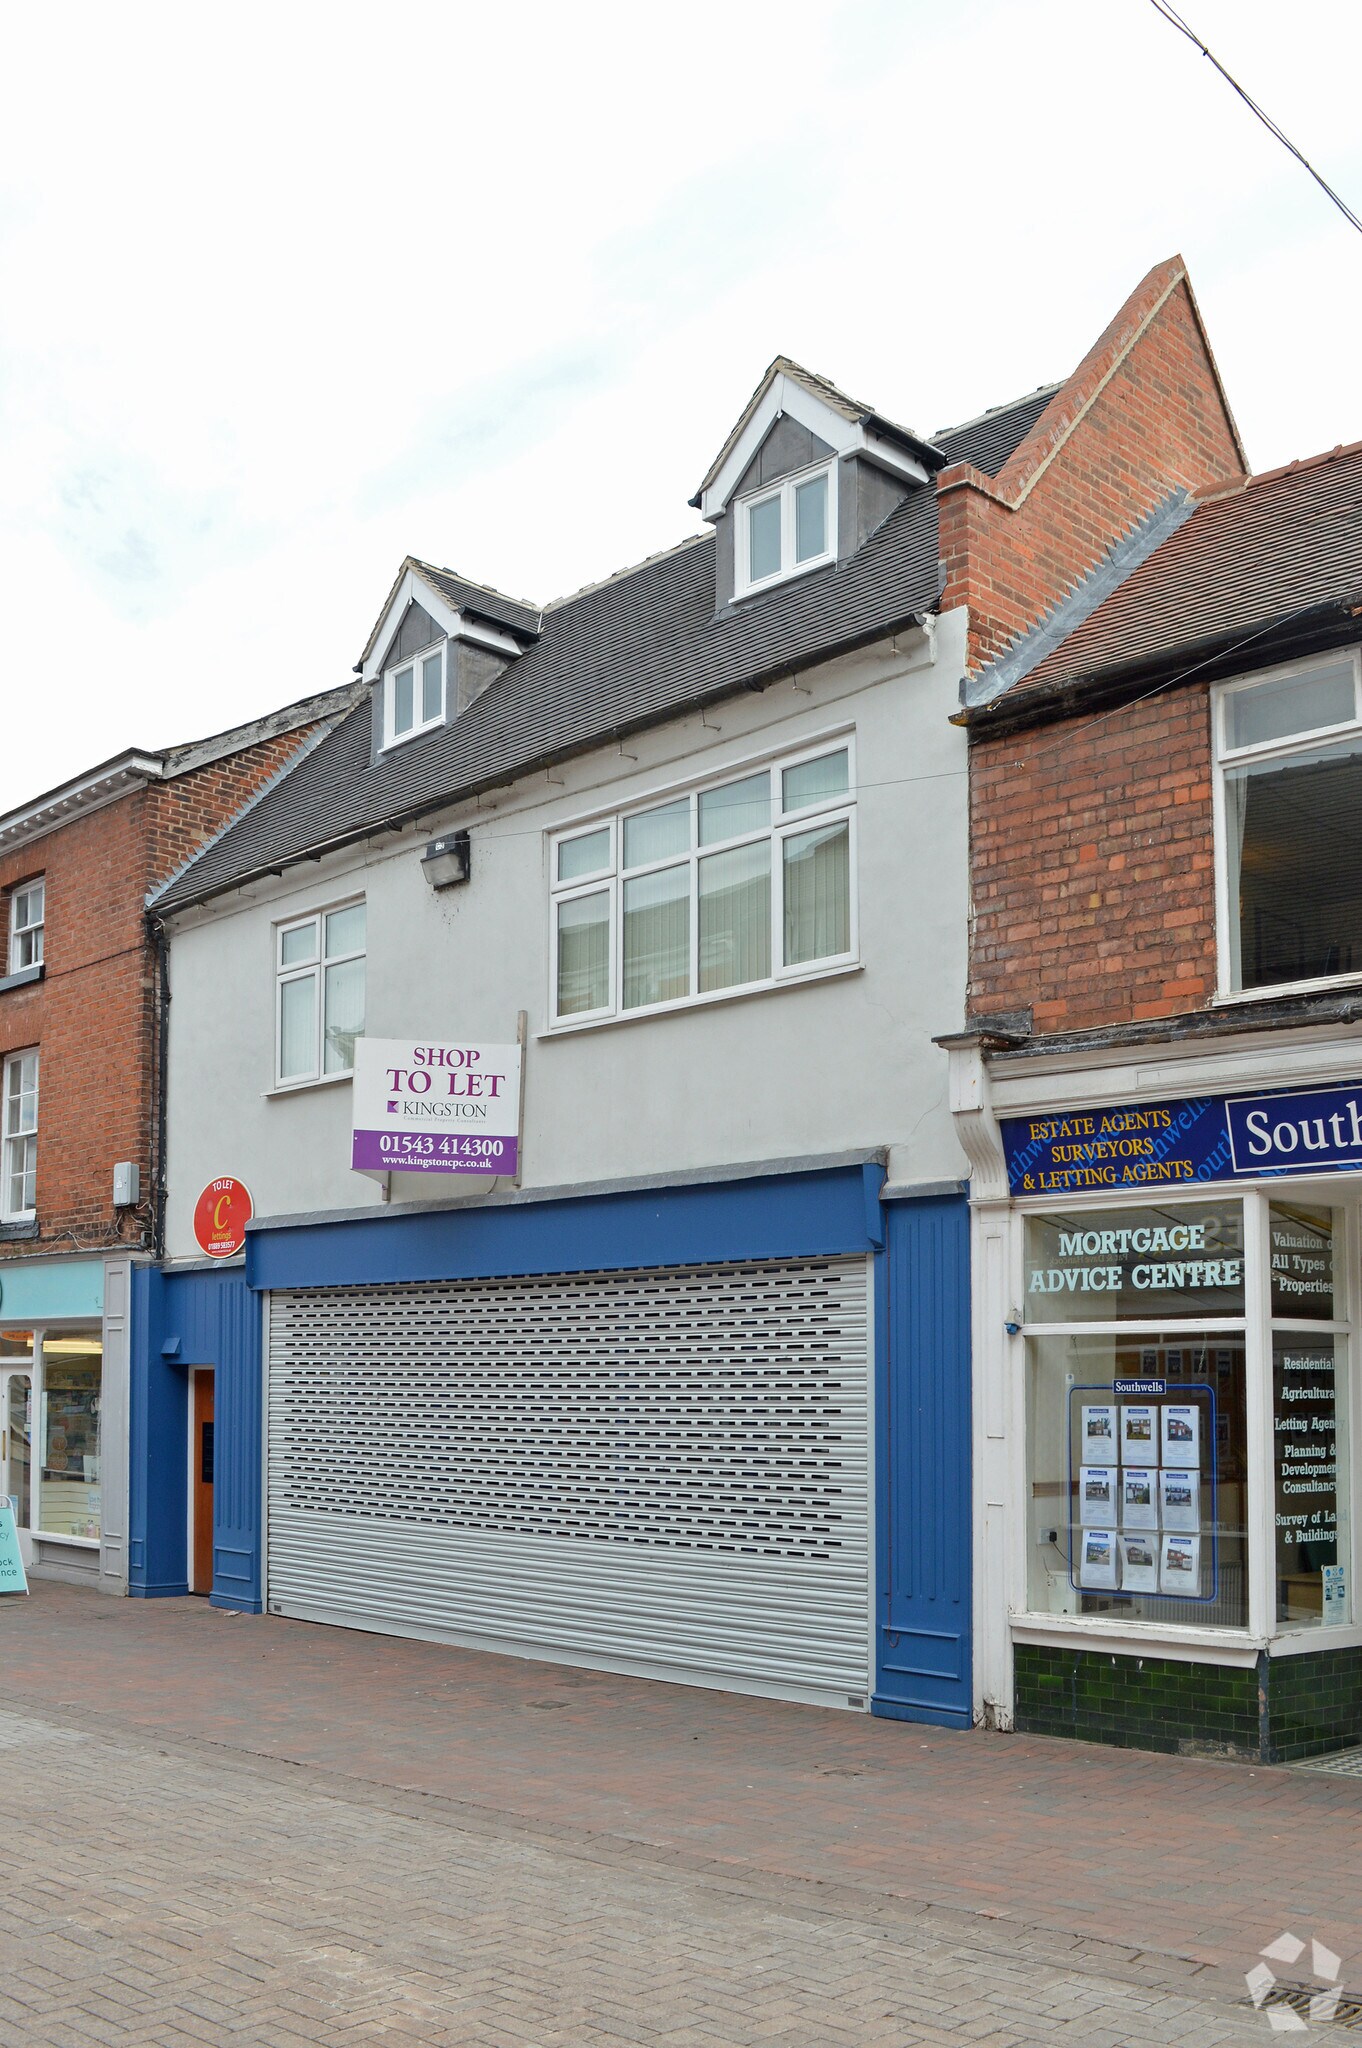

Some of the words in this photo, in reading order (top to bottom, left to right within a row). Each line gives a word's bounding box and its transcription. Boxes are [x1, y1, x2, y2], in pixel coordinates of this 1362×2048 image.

[413, 1047, 480, 1068] SHOP
[387, 1069, 432, 1094] TO
[447, 1072, 506, 1098] LET
[403, 1101, 487, 1118] KINGSTON
[1029, 1117, 1095, 1140] ESTATE
[1100, 1109, 1172, 1133] AGENTS
[379, 1135, 434, 1155] 01543
[438, 1136, 504, 1157] 414300
[1051, 1137, 1154, 1163] SURVEYORS
[382, 1155, 493, 1169] www.kingstoncpc.co.uk
[1023, 1173, 1036, 1190] &
[1038, 1166, 1116, 1189] LETTING
[1121, 1159, 1194, 1182] AGENTS
[212, 1180, 222, 1192] TO
[222, 1179, 234, 1190] LET
[213, 1195, 231, 1230] C
[211, 1232, 232, 1241] lettings
[1058, 1224, 1205, 1257] MORTGAGE
[1272, 1231, 1323, 1249] Valuation
[1272, 1254, 1289, 1269] All
[1292, 1254, 1326, 1274] Types
[1029, 1266, 1123, 1293] ADVICE
[1131, 1260, 1241, 1290] CENTRE
[1279, 1276, 1334, 1296] Properties
[1283, 1357, 1335, 1370] Residential
[1115, 1381, 1163, 1392] Southwells
[1281, 1386, 1336, 1402] Agricultura
[1274, 1417, 1308, 1433] Letting
[1284, 1444, 1327, 1459] Planning
[1281, 1462, 1339, 1478] Developmen
[1275, 1513, 1308, 1528] Survey
[1311, 1510, 1321, 1524] of
[1284, 1530, 1293, 1544] &
[1295, 1528, 1339, 1543] Buildings
[0, 1557, 13, 1567] ock
[0, 1568, 17, 1577] nce
